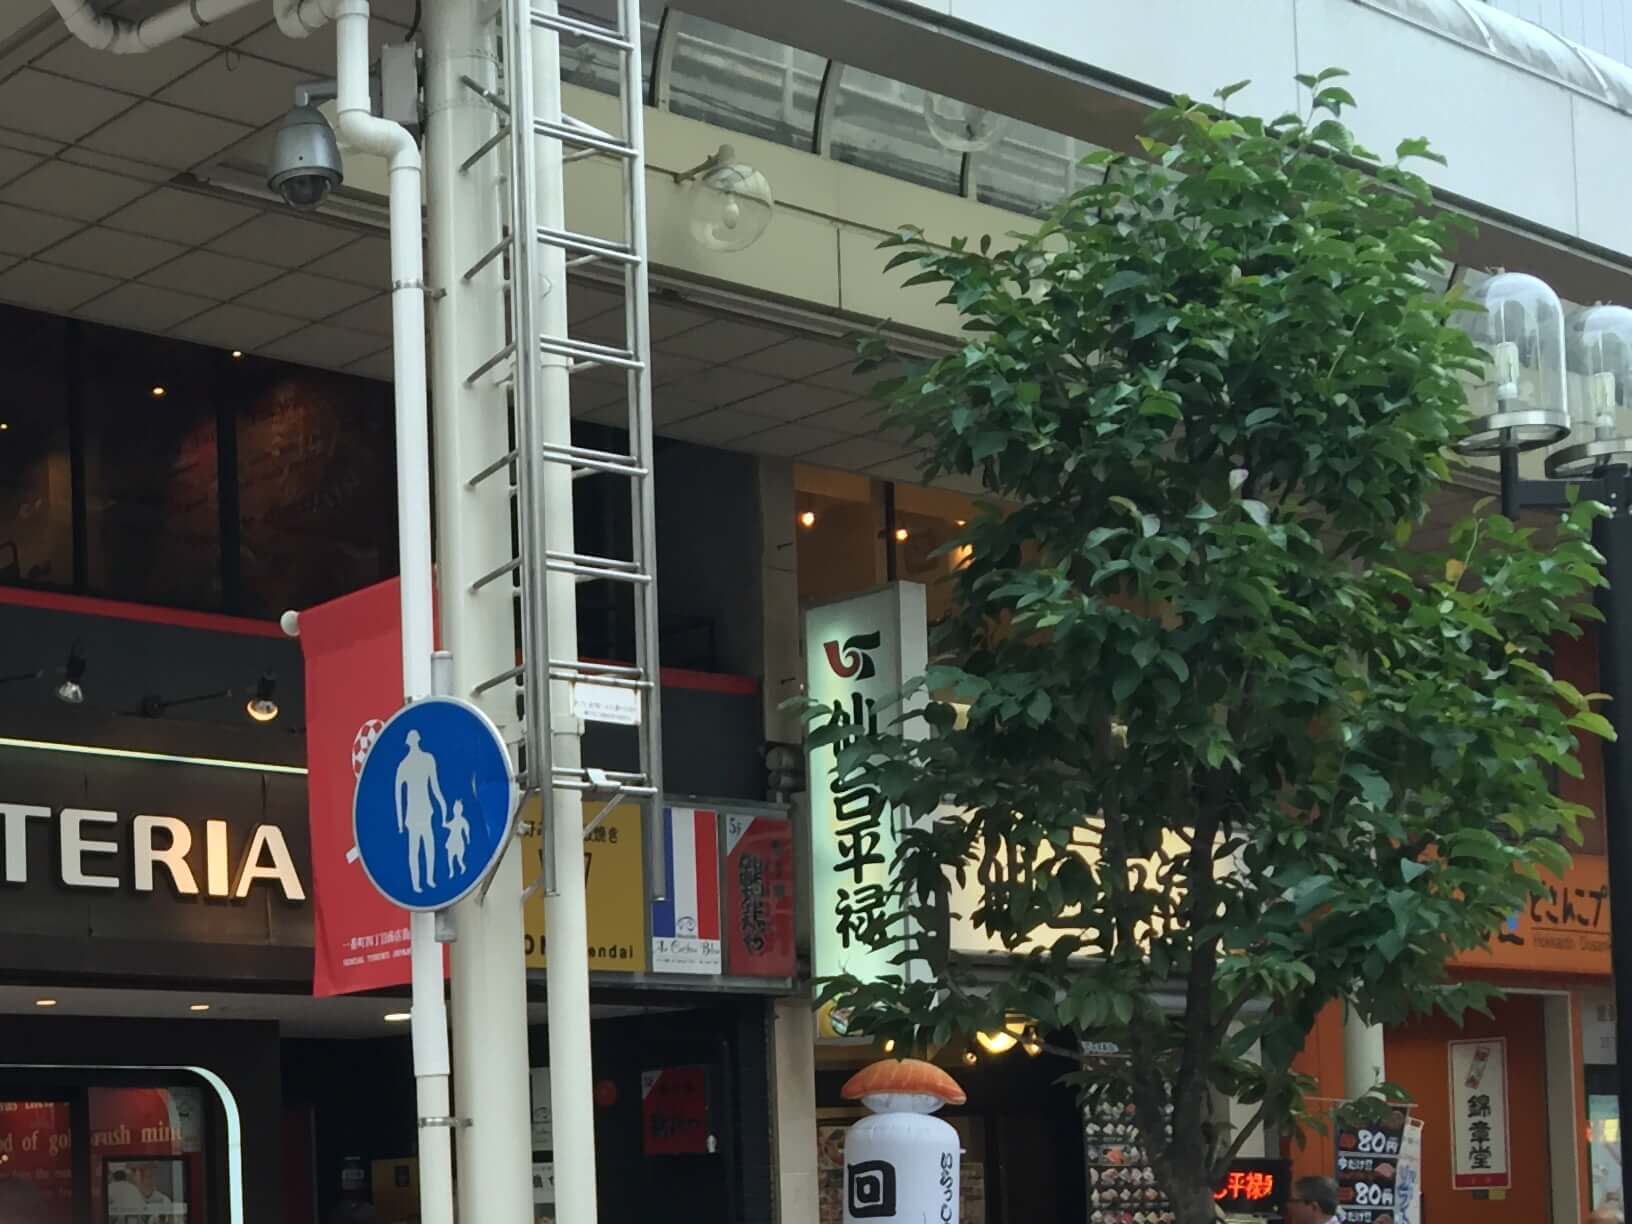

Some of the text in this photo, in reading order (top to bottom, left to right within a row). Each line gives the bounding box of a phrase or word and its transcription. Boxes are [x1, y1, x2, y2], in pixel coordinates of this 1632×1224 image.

[588, 945, 633, 958] endai
[22, 1130, 39, 1151] of
[49, 1127, 71, 1157] gol
[1357, 1129, 1398, 1153] 80円
[1355, 1181, 1394, 1205] 80円
